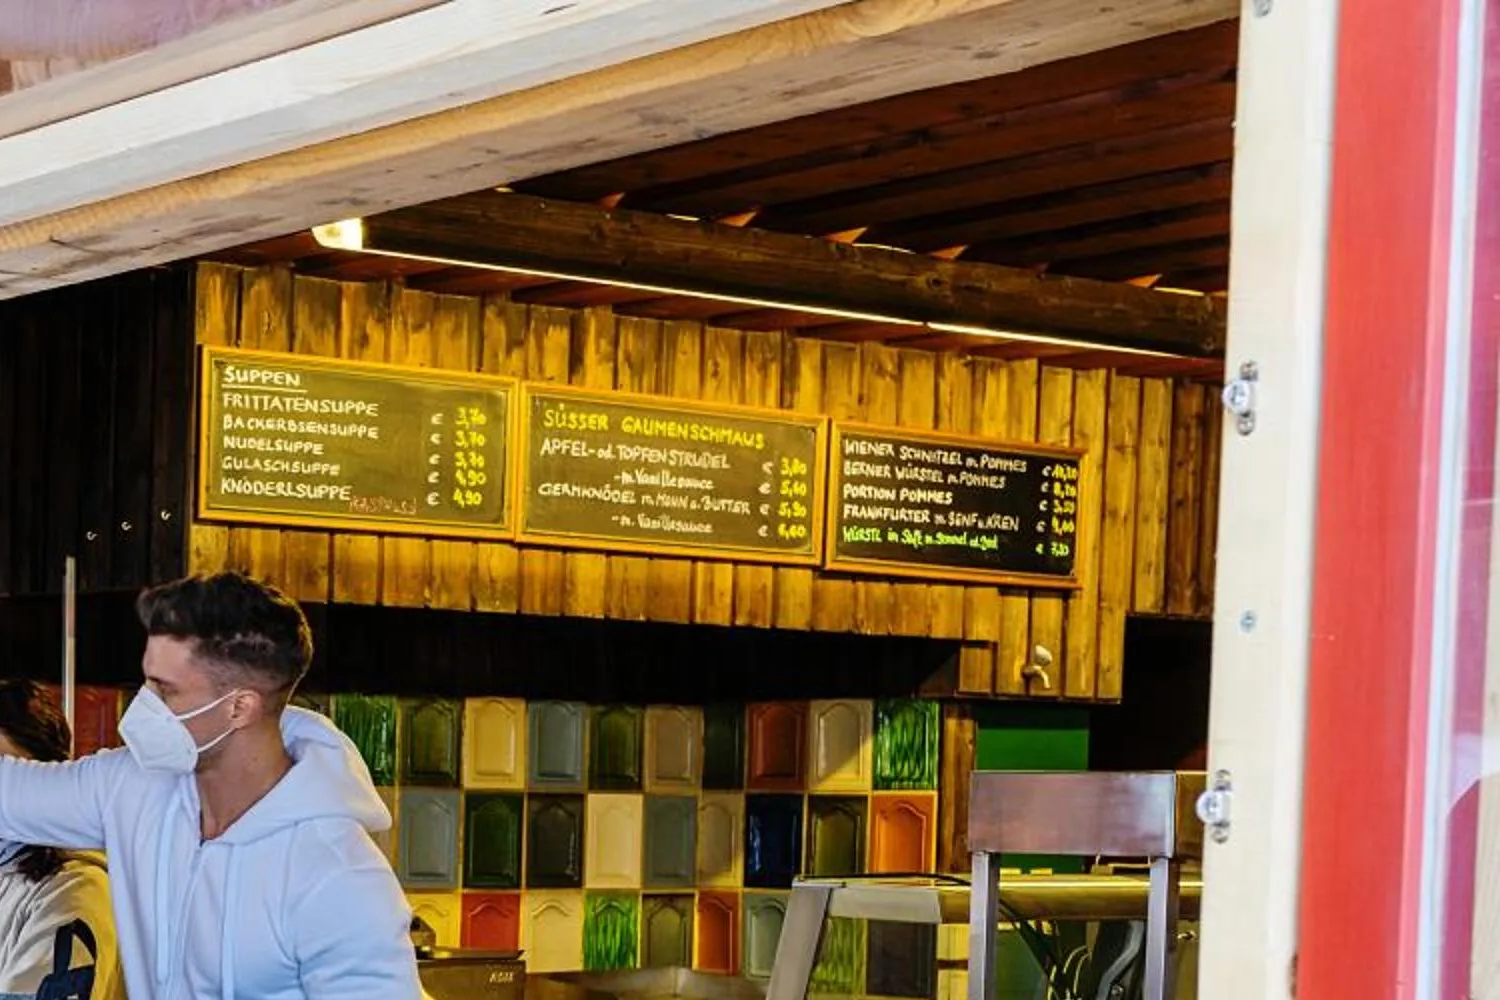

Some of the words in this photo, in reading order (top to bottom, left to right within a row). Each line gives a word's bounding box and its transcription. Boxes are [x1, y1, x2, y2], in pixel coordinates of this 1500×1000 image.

[224, 366, 300, 387] SUPPEN
[223, 392, 380, 417] FRITTATENSUPPE
[543, 403, 609, 431] SÜSSER
[621, 414, 765, 450] GAUMENSCHMAUS
[223, 436, 325, 455] NUDELSUPPE
[844, 438, 894, 457] WIENER
[899, 445, 963, 466] SCHNITZEL
[221, 456, 341, 476] GULASCHSUPPE
[843, 459, 891, 478] BERNER
[843, 482, 896, 501] PORTION
[899, 487, 953, 505] POMMES
[843, 503, 931, 523] FRANKFURTER
